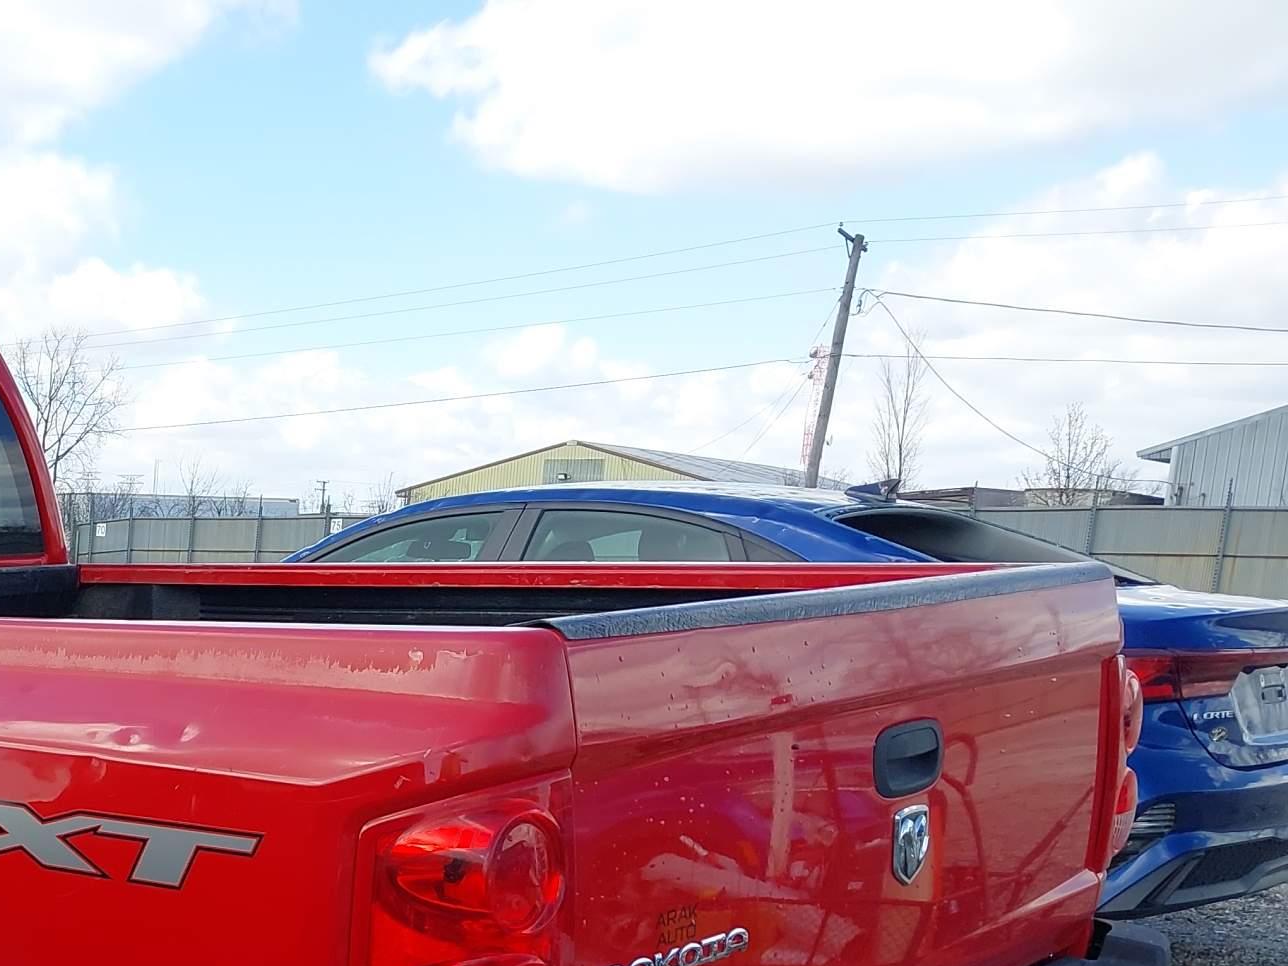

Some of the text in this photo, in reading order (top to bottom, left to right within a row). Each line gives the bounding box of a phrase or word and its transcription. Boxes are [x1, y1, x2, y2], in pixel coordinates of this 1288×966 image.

[97, 525, 106, 535] 70
[331, 520, 341, 531] 75
[655, 903, 698, 929] ARAK
[655, 923, 697, 949] AUTO
